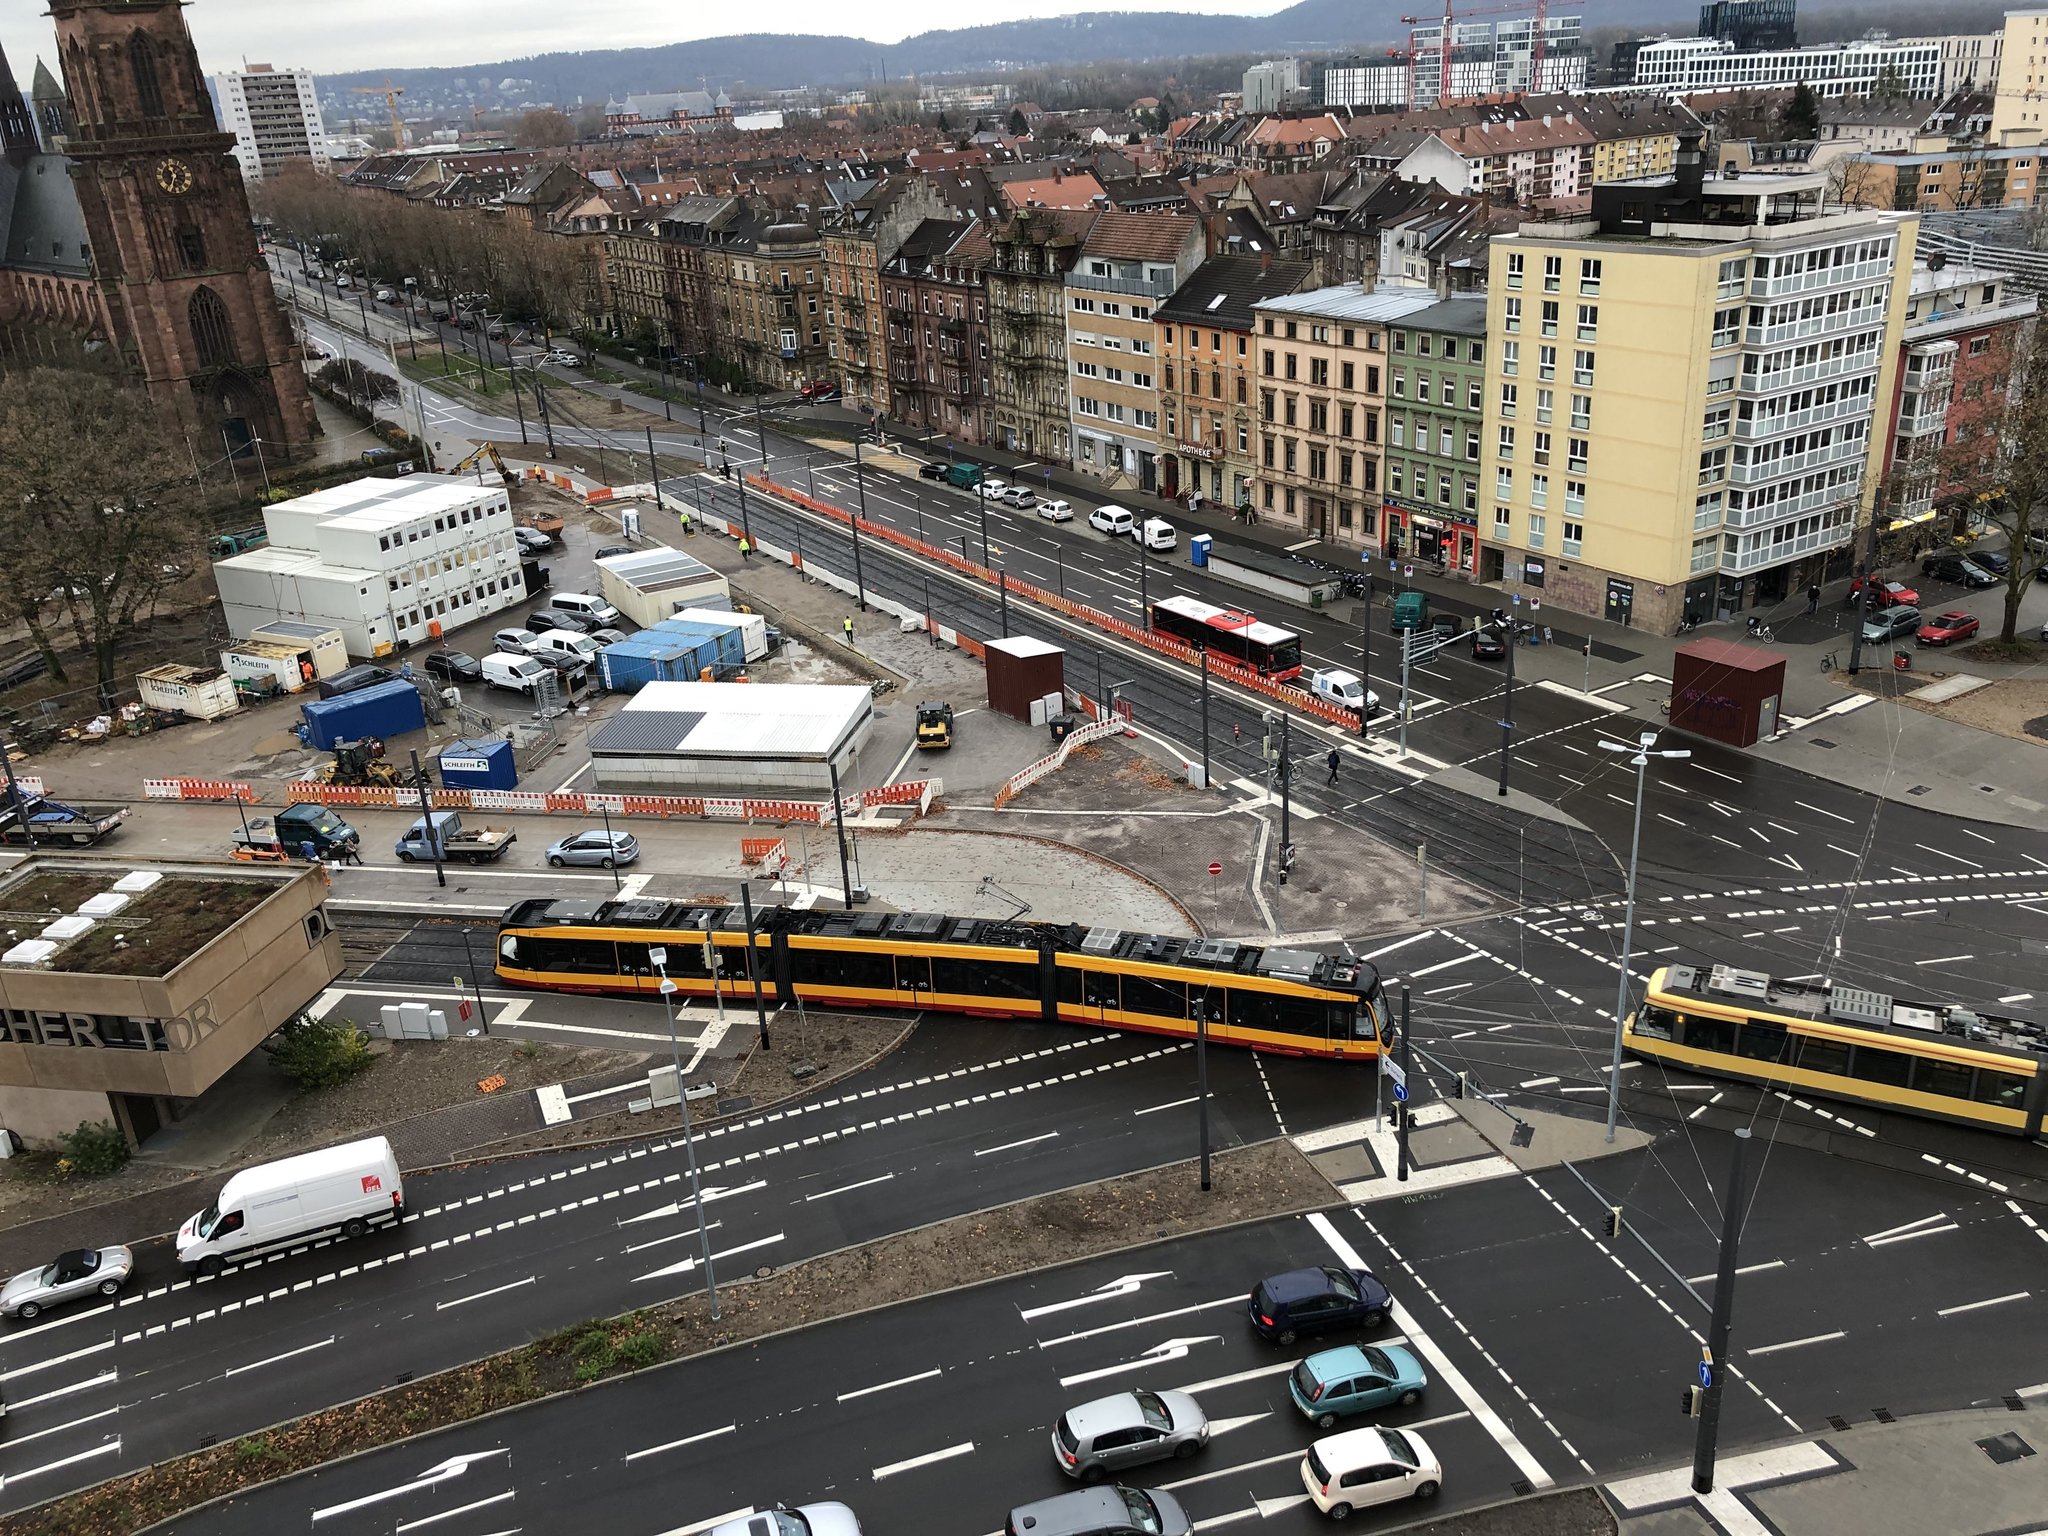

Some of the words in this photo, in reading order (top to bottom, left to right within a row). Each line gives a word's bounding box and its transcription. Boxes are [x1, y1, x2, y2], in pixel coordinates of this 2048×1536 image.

[1179, 444, 1211, 458] APOTHEKE
[241, 660, 270, 670] SCHLEITH
[151, 684, 178, 696] SCHLEITH
[0, 1009, 105, 1048] HER
[129, 999, 219, 1053] TOR
[365, 1184, 382, 1193] GEL
